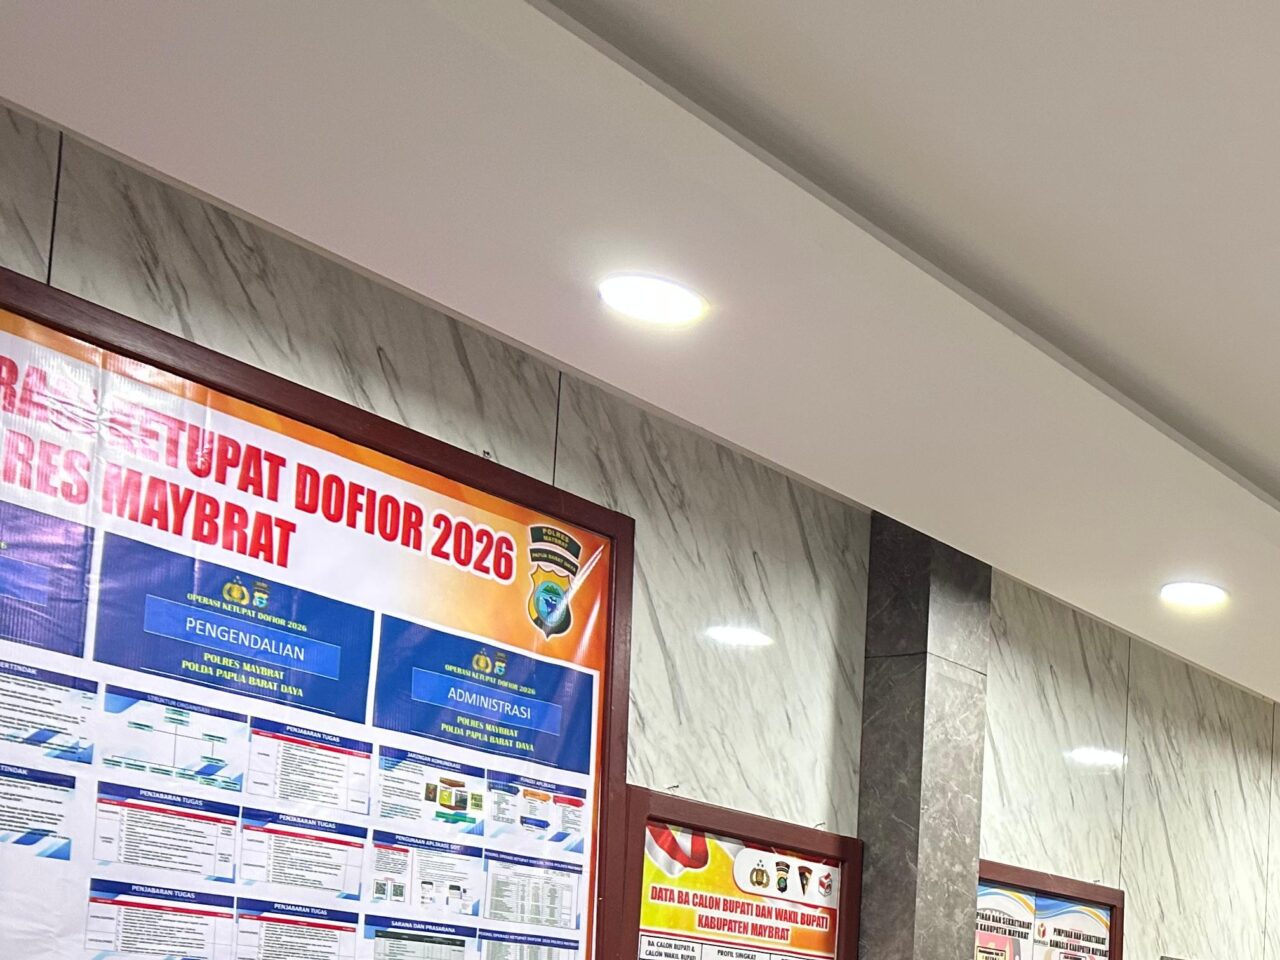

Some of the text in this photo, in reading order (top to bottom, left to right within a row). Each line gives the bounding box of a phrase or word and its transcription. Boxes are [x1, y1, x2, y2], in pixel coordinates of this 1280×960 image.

[102, 463, 297, 568] MAYBRAT
[295, 463, 423, 551] DOFIOR
[432, 514, 514, 580] 2026
[187, 593, 307, 632] OPERASI KETUPAT DOFIOR 2026
[185, 617, 305, 661] PENGENDALIAN
[203, 652, 284, 680] POLRES MAYBRAT
[444, 664, 471, 678] OPERASI
[181, 660, 303, 697] POLDA PAPUA BARAT DAYA
[448, 687, 531, 720] ADMINISTRASI
[456, 716, 519, 737] POLRES MAYBRAT
[322, 732, 340, 743] TUGAS
[441, 723, 464, 736] POLDA
[490, 734, 513, 747] BARAT
[515, 740, 534, 752] DAYA
[182, 797, 203, 807] TUGAS
[317, 820, 336, 829] TUGAS
[132, 885, 195, 899] PENJABARAN TUGAS
[274, 903, 328, 916] PENJABARAN TUGAS
[651, 886, 828, 929] DATA BA CALON BUPATI DAN WAKIL BUPATI
[698, 914, 790, 941] KABUPATEN MAYBRAT
[1002, 916, 1032, 930] SEKRETARIAT
[645, 950, 663, 958] CALON
[664, 952, 679, 960] WAKIL
[656, 941, 672, 950] CALON
[674, 943, 690, 951] BUPATI
[717, 949, 757, 960] PROFIL SINGKAT
